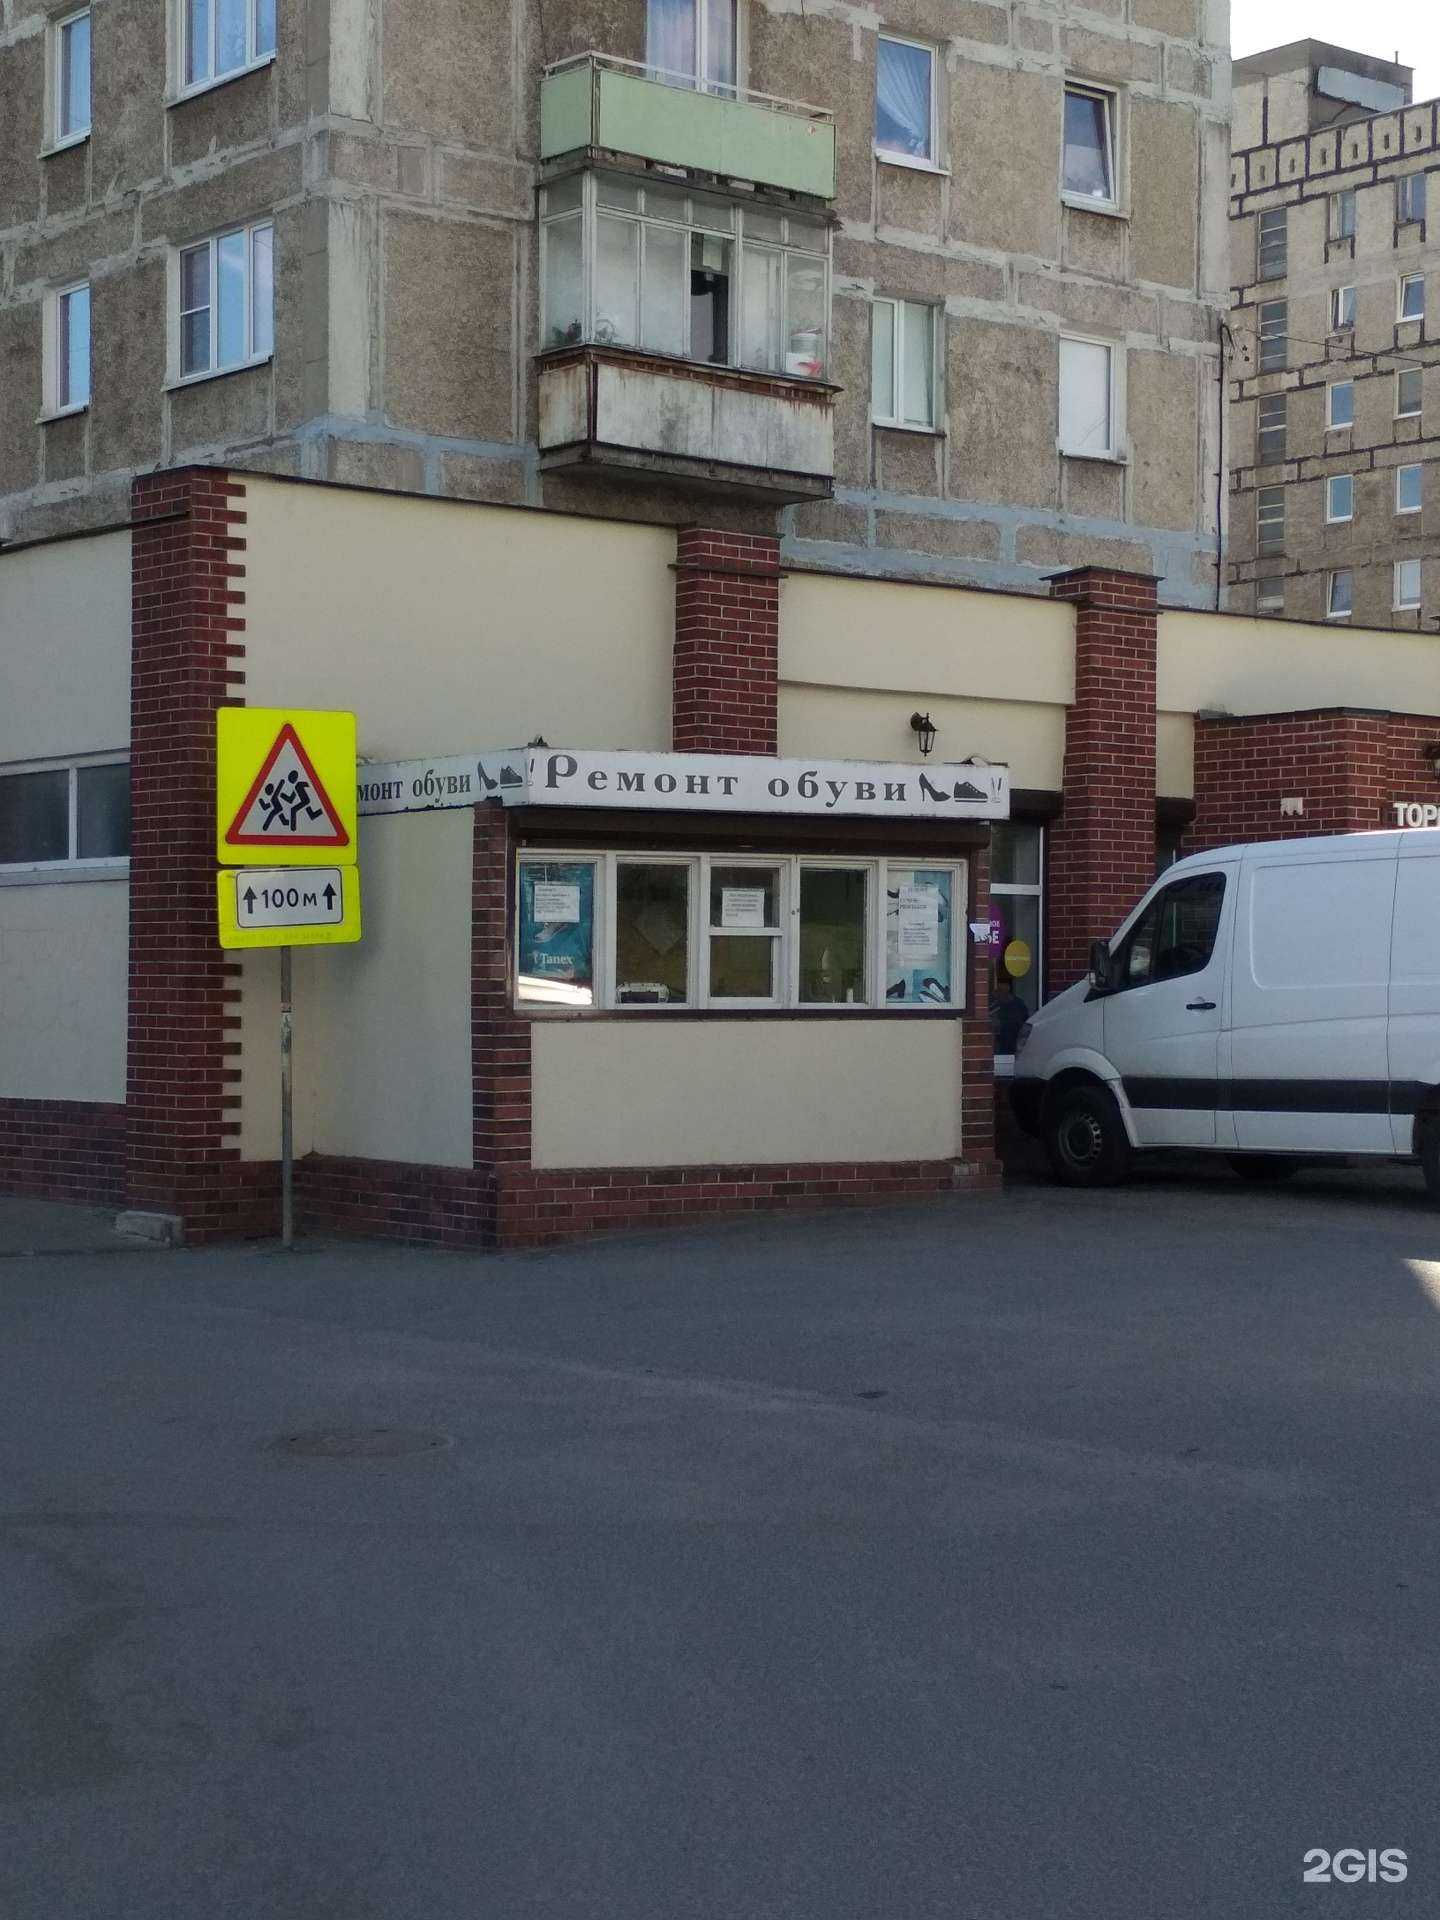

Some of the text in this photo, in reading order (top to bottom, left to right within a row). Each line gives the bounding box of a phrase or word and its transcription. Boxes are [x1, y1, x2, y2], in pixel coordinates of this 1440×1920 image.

[357, 768, 471, 803] монт обуви
[545, 754, 907, 808] Ремонт обуви
[1392, 802, 1440, 827] ТОР
